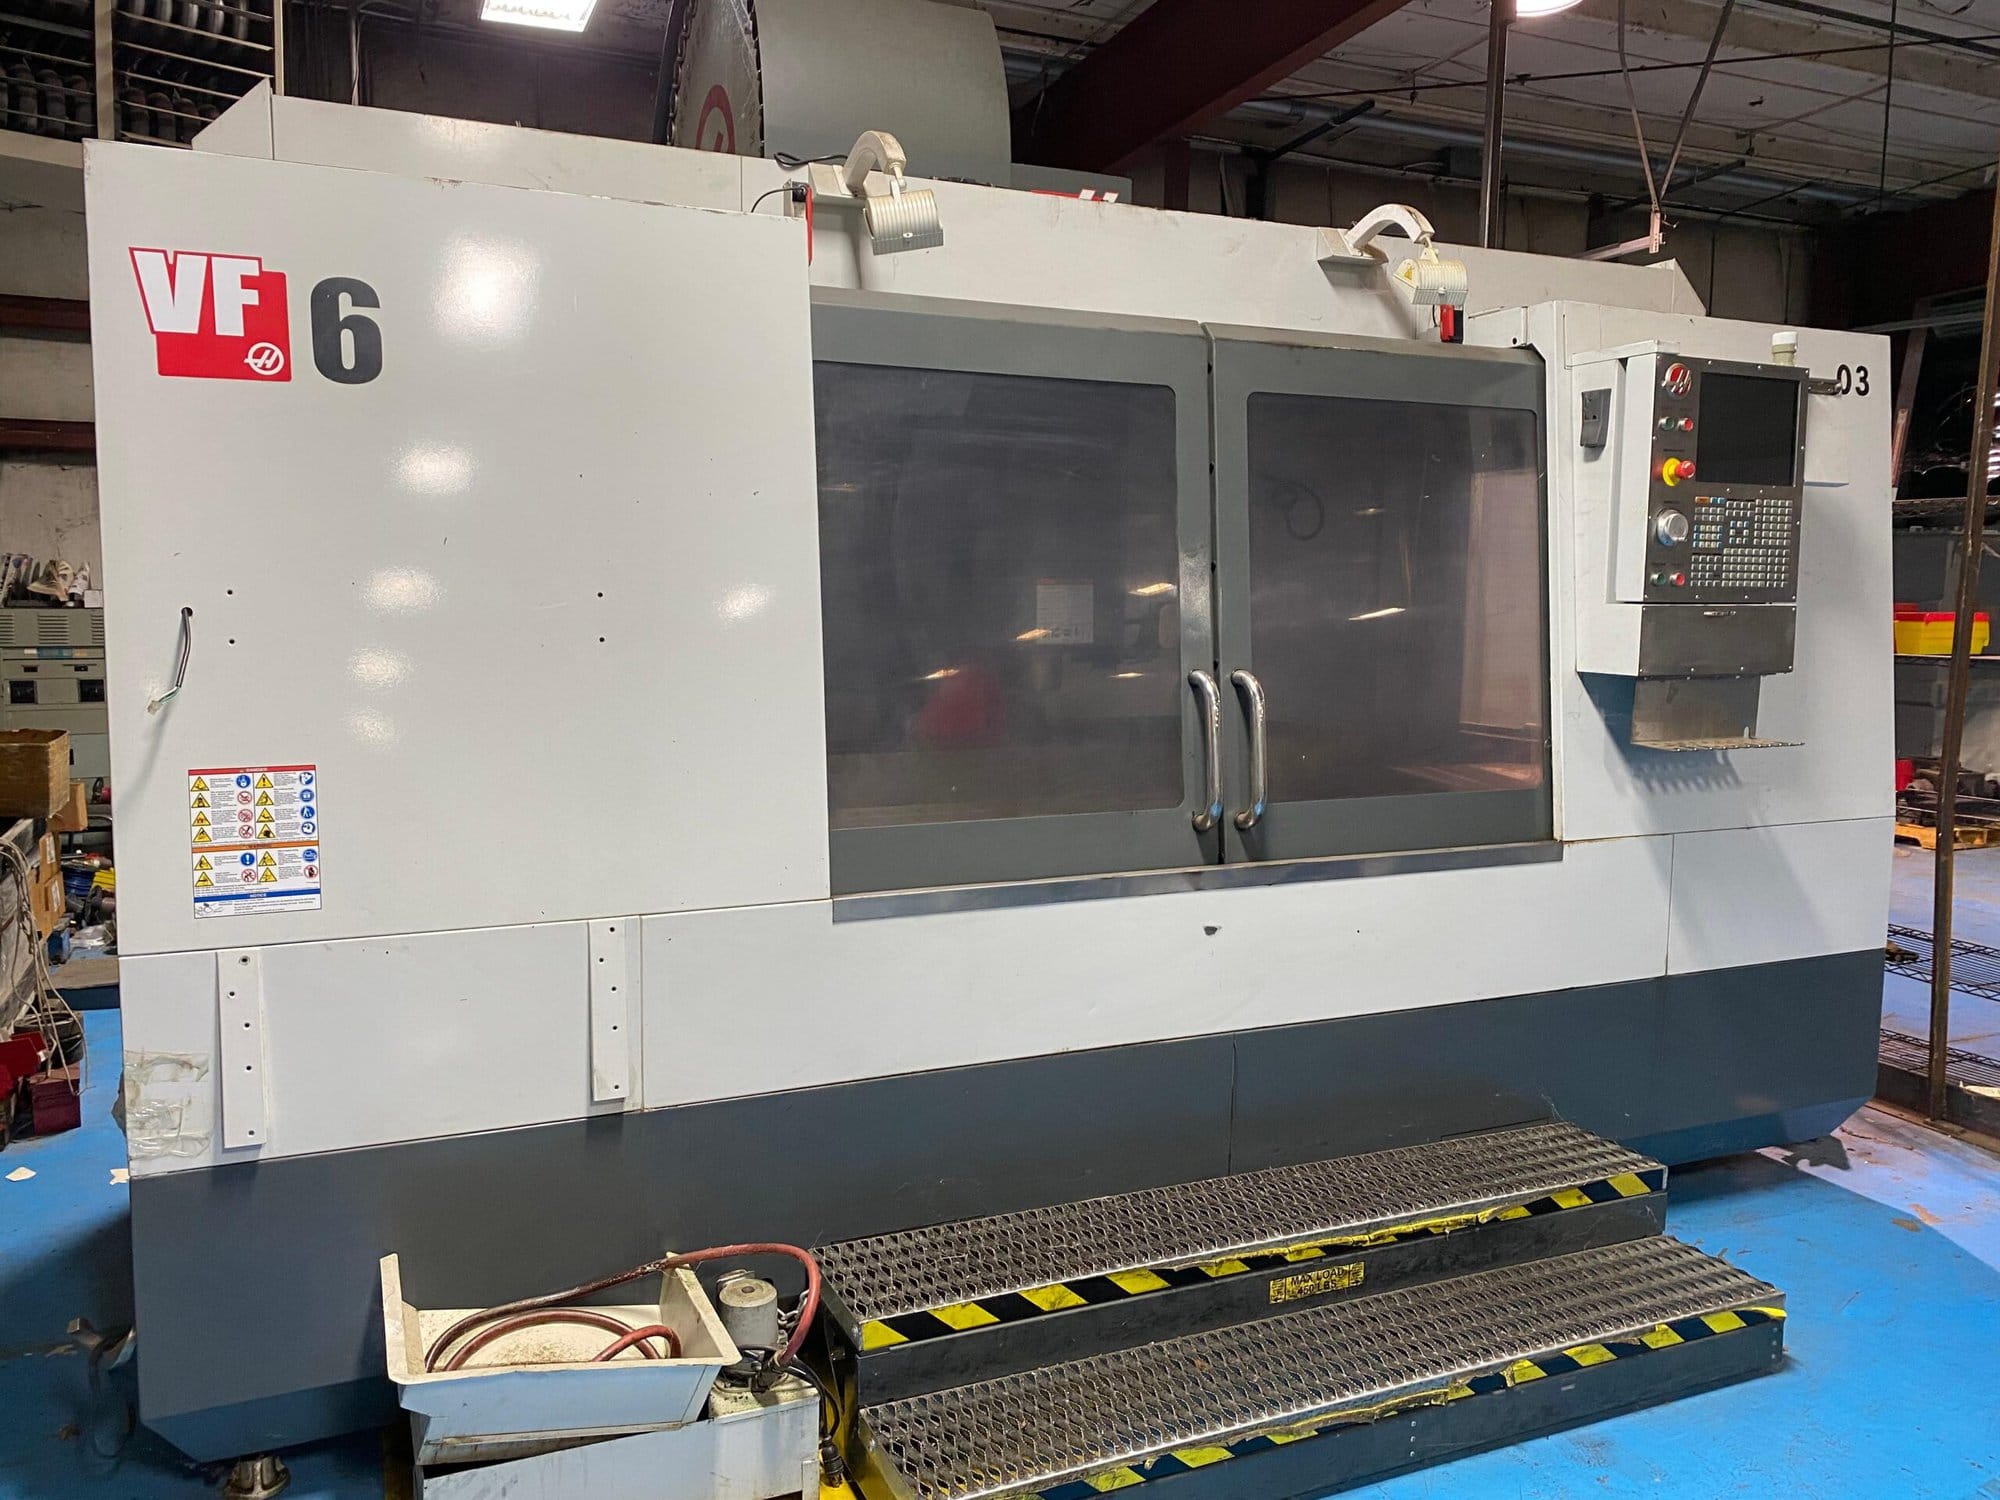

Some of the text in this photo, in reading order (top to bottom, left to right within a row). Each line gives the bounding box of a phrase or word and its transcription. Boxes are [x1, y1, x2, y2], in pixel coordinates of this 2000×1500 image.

[131, 248, 383, 385] VF 6
[1836, 364, 1870, 396] 03
[1291, 1273, 1313, 1286] MAX
[1316, 1268, 1345, 1281] LOAD
[1296, 1284, 1315, 1295] 450
[1317, 1279, 1337, 1291] LBS
